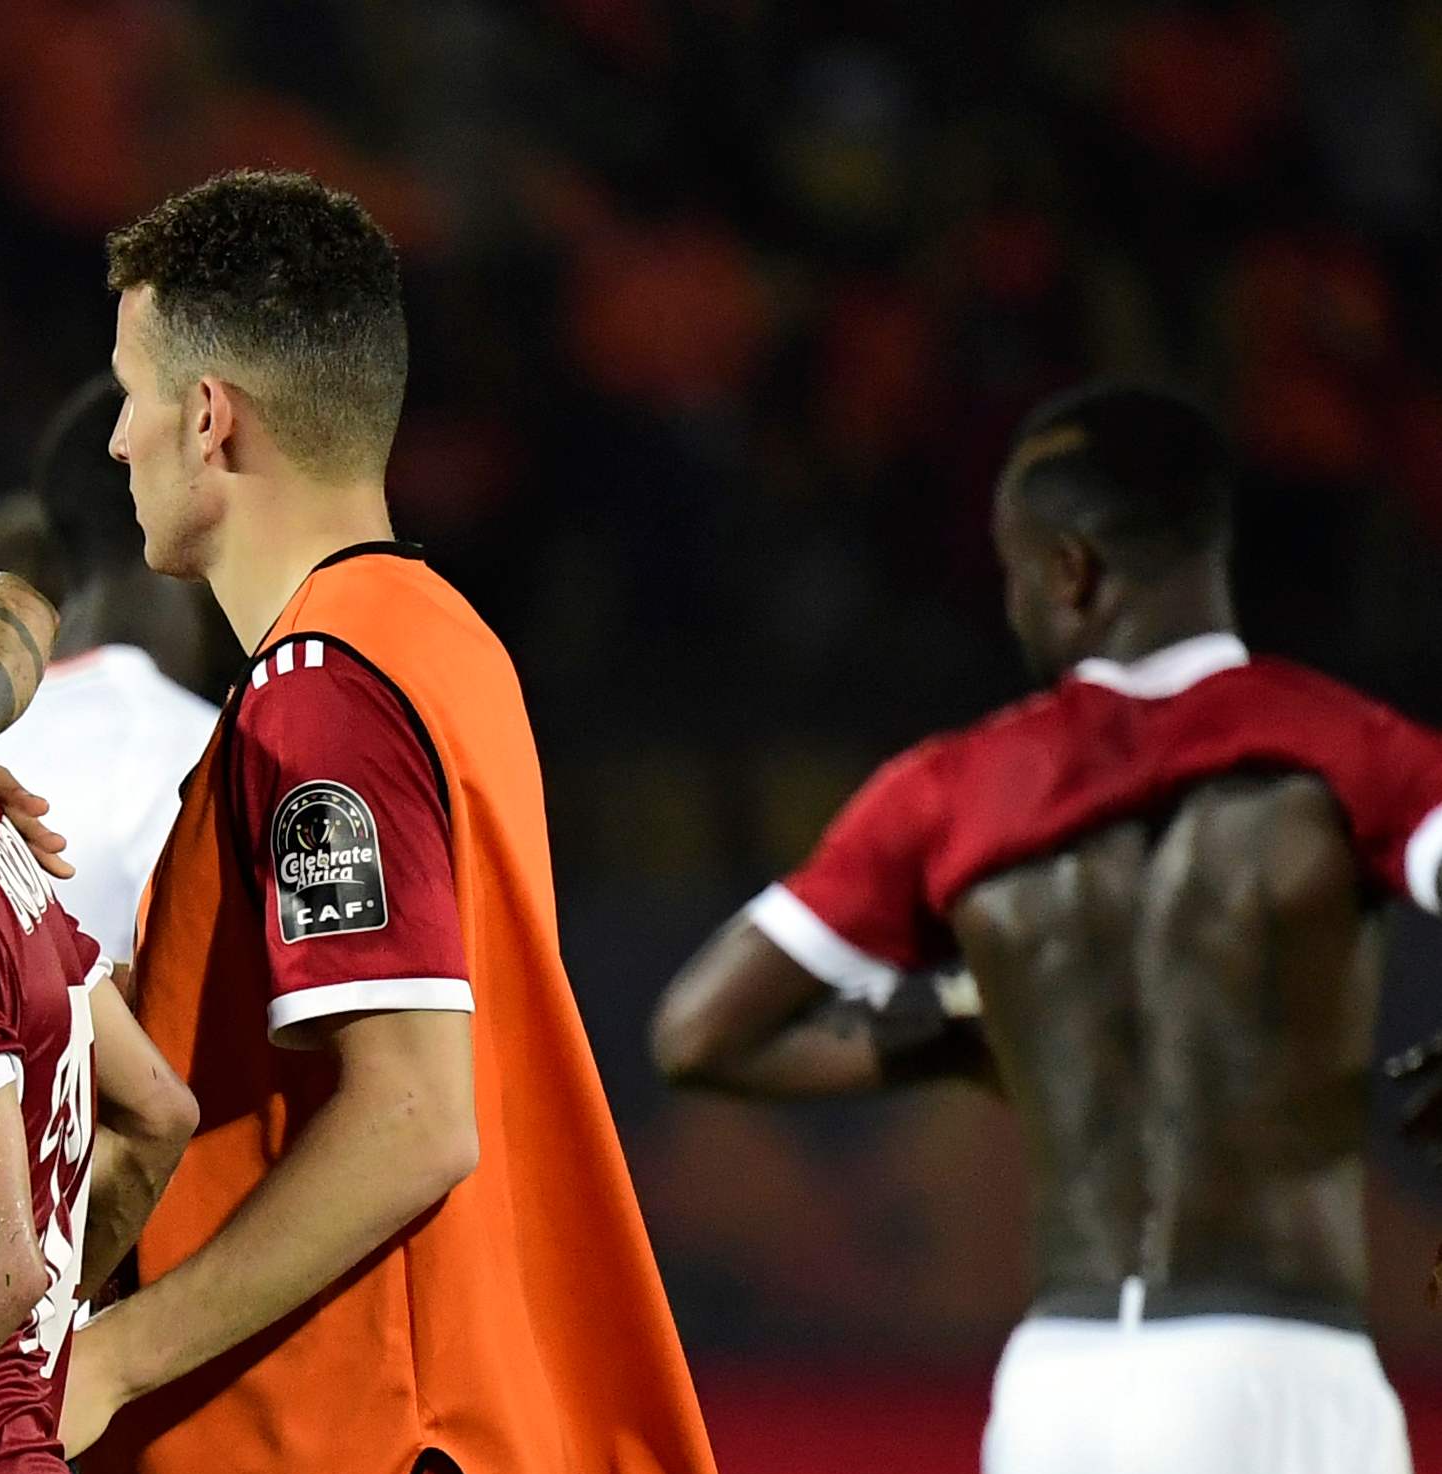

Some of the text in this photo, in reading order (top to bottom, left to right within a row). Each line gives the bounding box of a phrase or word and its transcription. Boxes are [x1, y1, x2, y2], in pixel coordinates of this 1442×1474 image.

[280, 846, 373, 884] Celebrate
[296, 866, 354, 893] Africa
[296, 901, 363, 926] CAF
